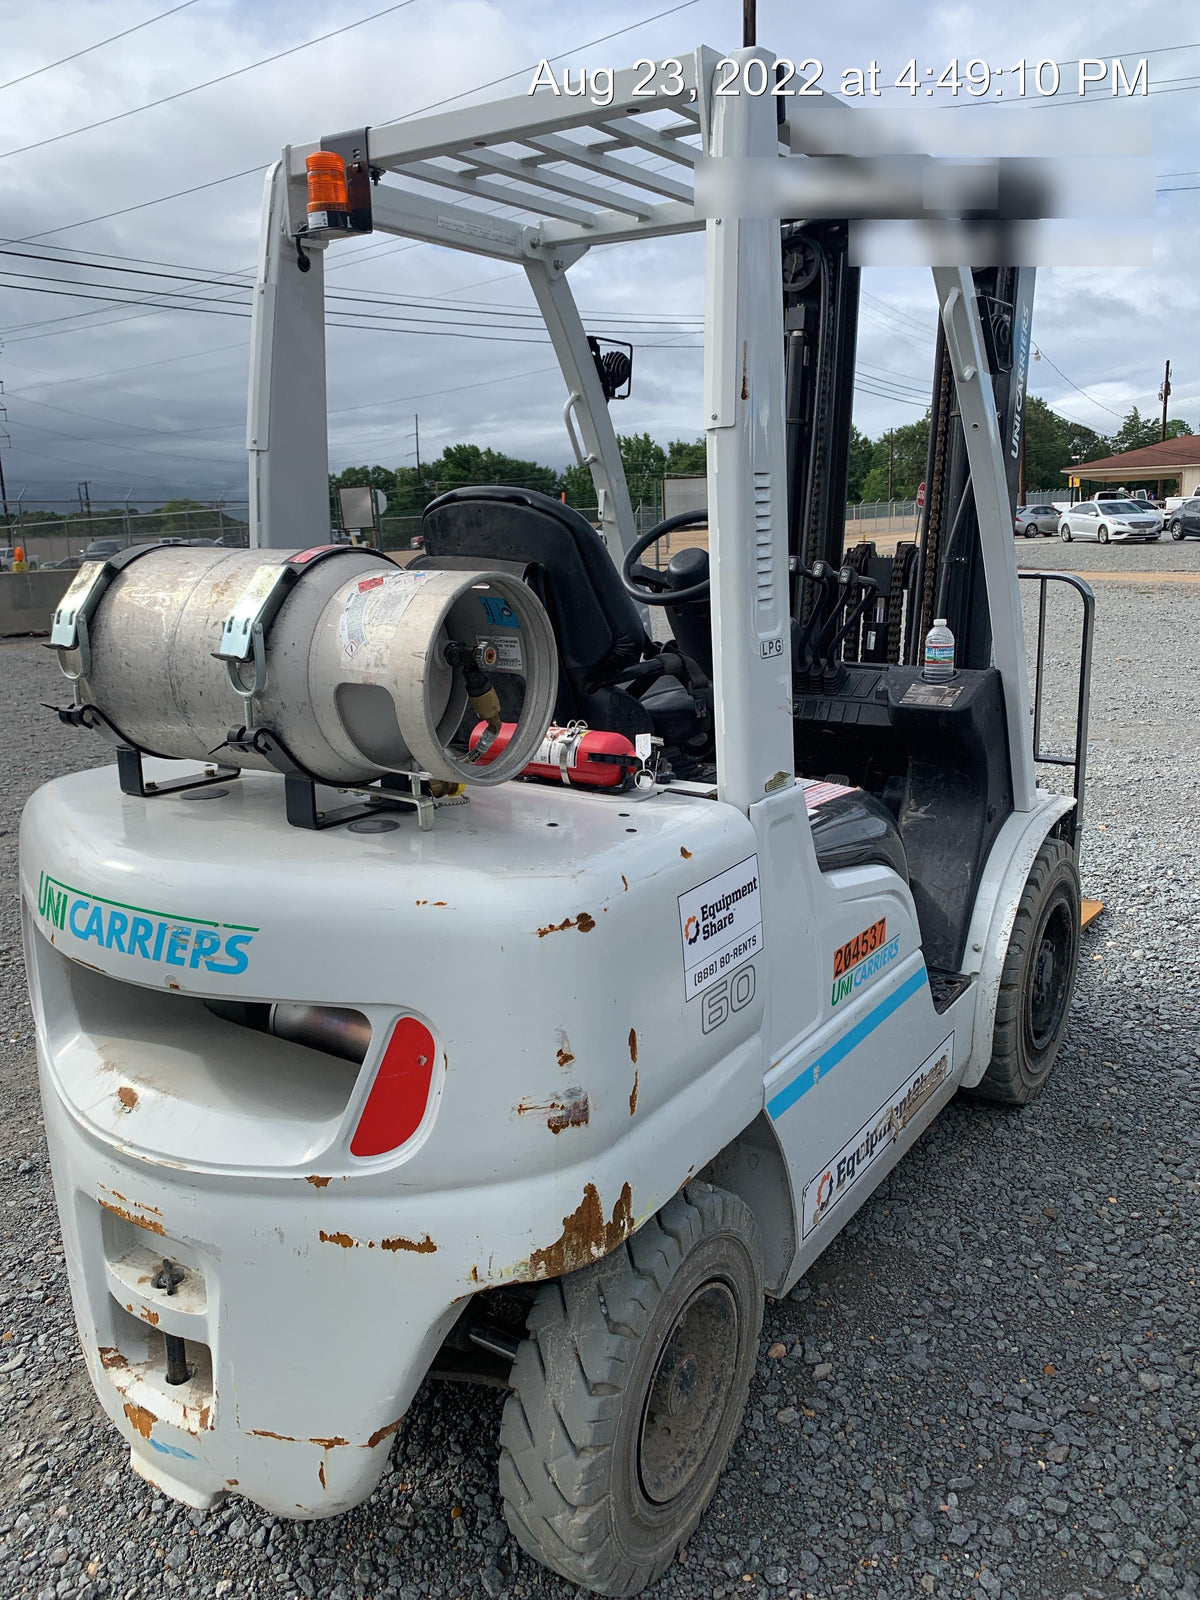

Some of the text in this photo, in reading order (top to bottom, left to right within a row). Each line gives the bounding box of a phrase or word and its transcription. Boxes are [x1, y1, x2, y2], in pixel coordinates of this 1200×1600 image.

[1011, 302, 1030, 460] UNICARRIERS
[762, 638, 782, 656] LPG
[38, 870, 260, 975] UNICARRIERS
[700, 876, 758, 922] Equipment
[702, 912, 735, 941] Share
[694, 934, 757, 986] (888) 80-RENTS
[831, 935, 900, 1006] UNICARRIERS
[835, 917, 887, 978] 204537
[702, 965, 756, 1035] 60
